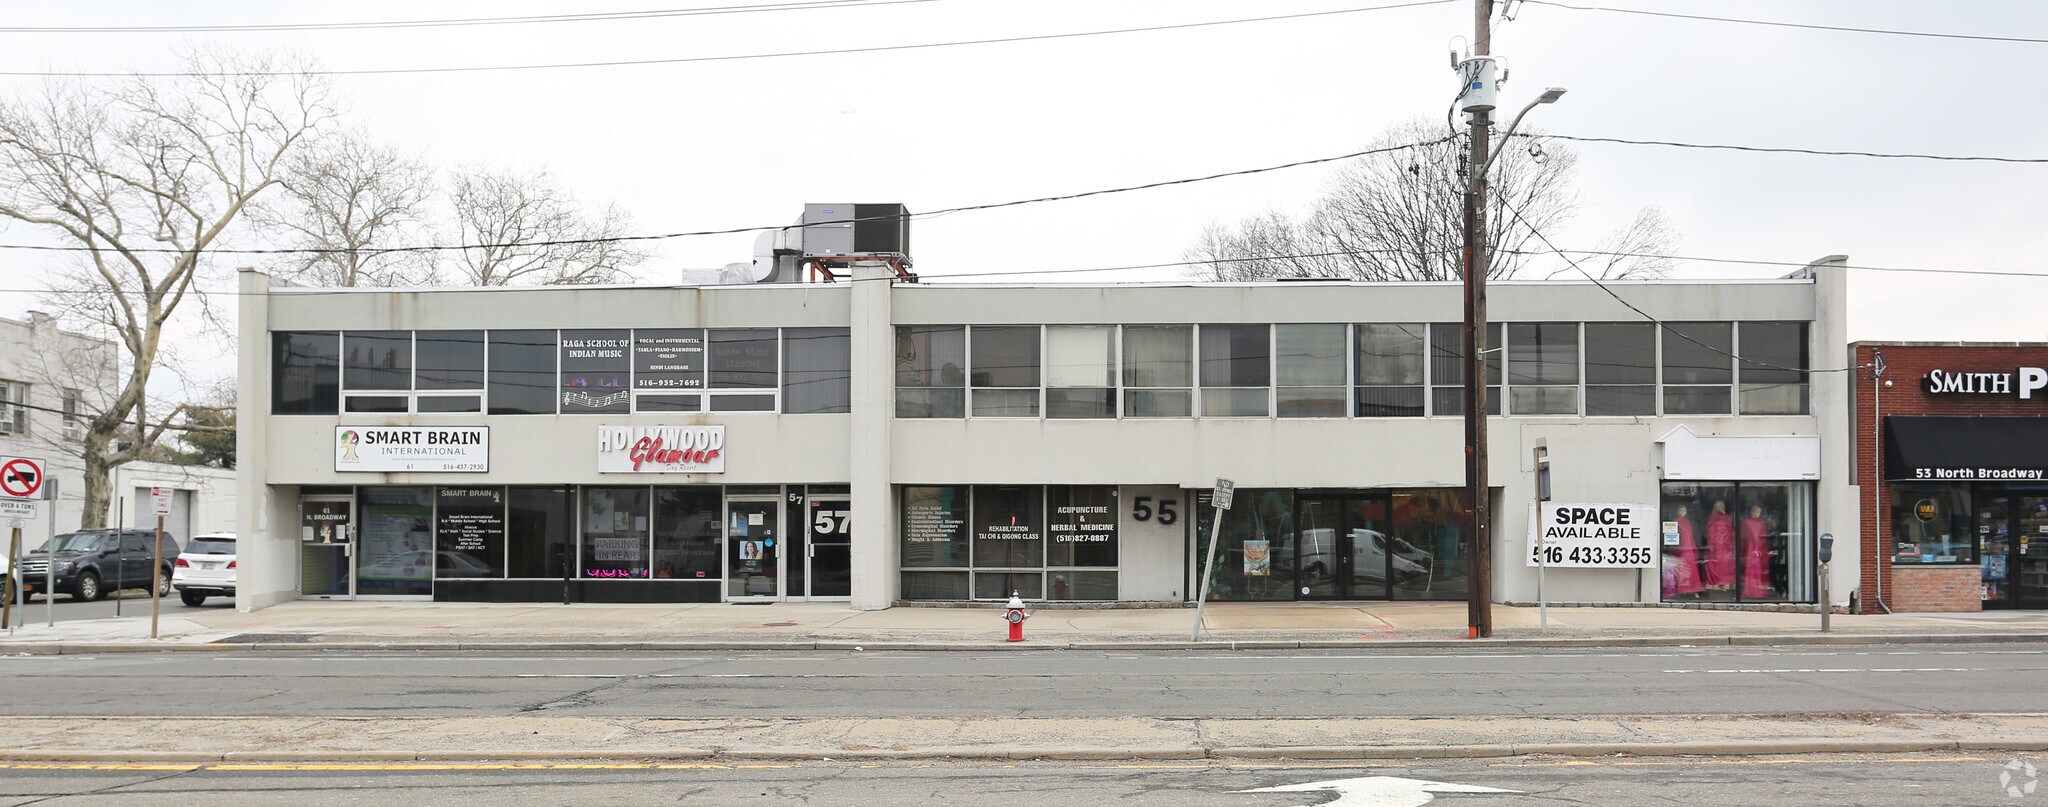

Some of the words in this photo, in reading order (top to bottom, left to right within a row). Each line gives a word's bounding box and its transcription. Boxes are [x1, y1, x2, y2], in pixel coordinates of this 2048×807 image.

[365, 431, 422, 445] SMART
[428, 431, 481, 445] BRAIN
[381, 447, 467, 455] INTERNATIONAL
[629, 436, 719, 471] Glamour
[1916, 468, 1931, 478] 53
[1936, 468, 1974, 478] North
[1978, 468, 2043, 479] Broadway
[788, 493, 803, 504] 57
[1057, 506, 1108, 514] ACUPUNCTURE
[1132, 496, 1177, 525] 55
[1555, 507, 1631, 525] SPACE
[814, 510, 851, 534] 57
[1051, 523, 1077, 531] HERBAL
[1080, 523, 1114, 531] MEDICINE
[1545, 527, 1641, 539] AVAILABLE
[595, 539, 639, 549] PARKING
[598, 551, 609, 560] IN
[611, 551, 637, 560] REAR
[1532, 546, 1563, 563] 516
